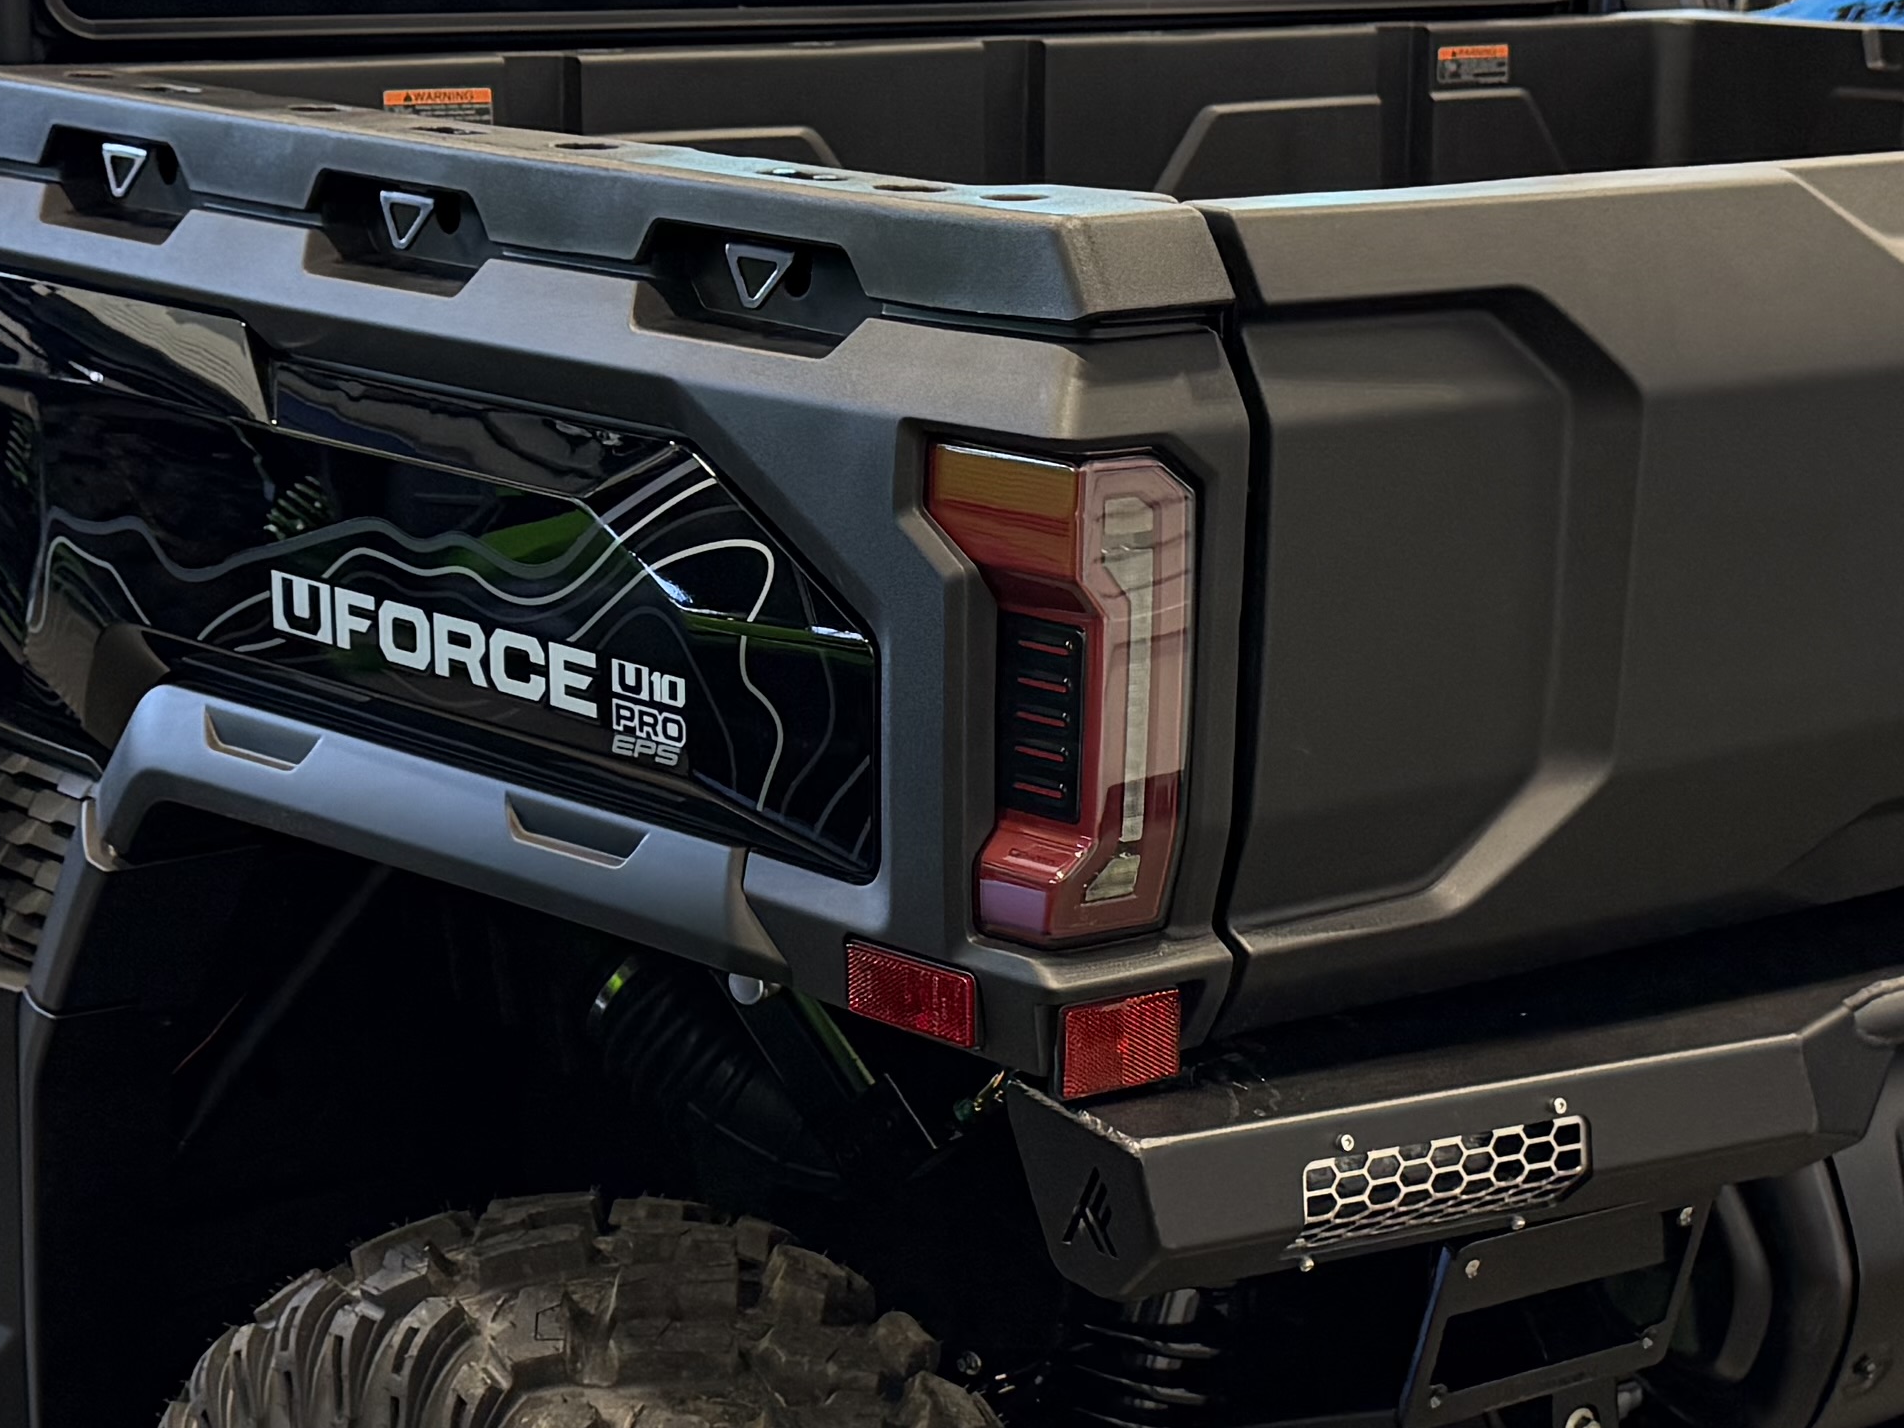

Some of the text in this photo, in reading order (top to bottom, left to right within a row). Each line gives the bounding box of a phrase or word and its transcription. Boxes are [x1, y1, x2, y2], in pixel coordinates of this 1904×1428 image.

[412, 90, 475, 103] WARNING
[270, 569, 686, 718] UFORCE U10
[611, 699, 687, 748] PRO
[611, 733, 682, 766] EPS
